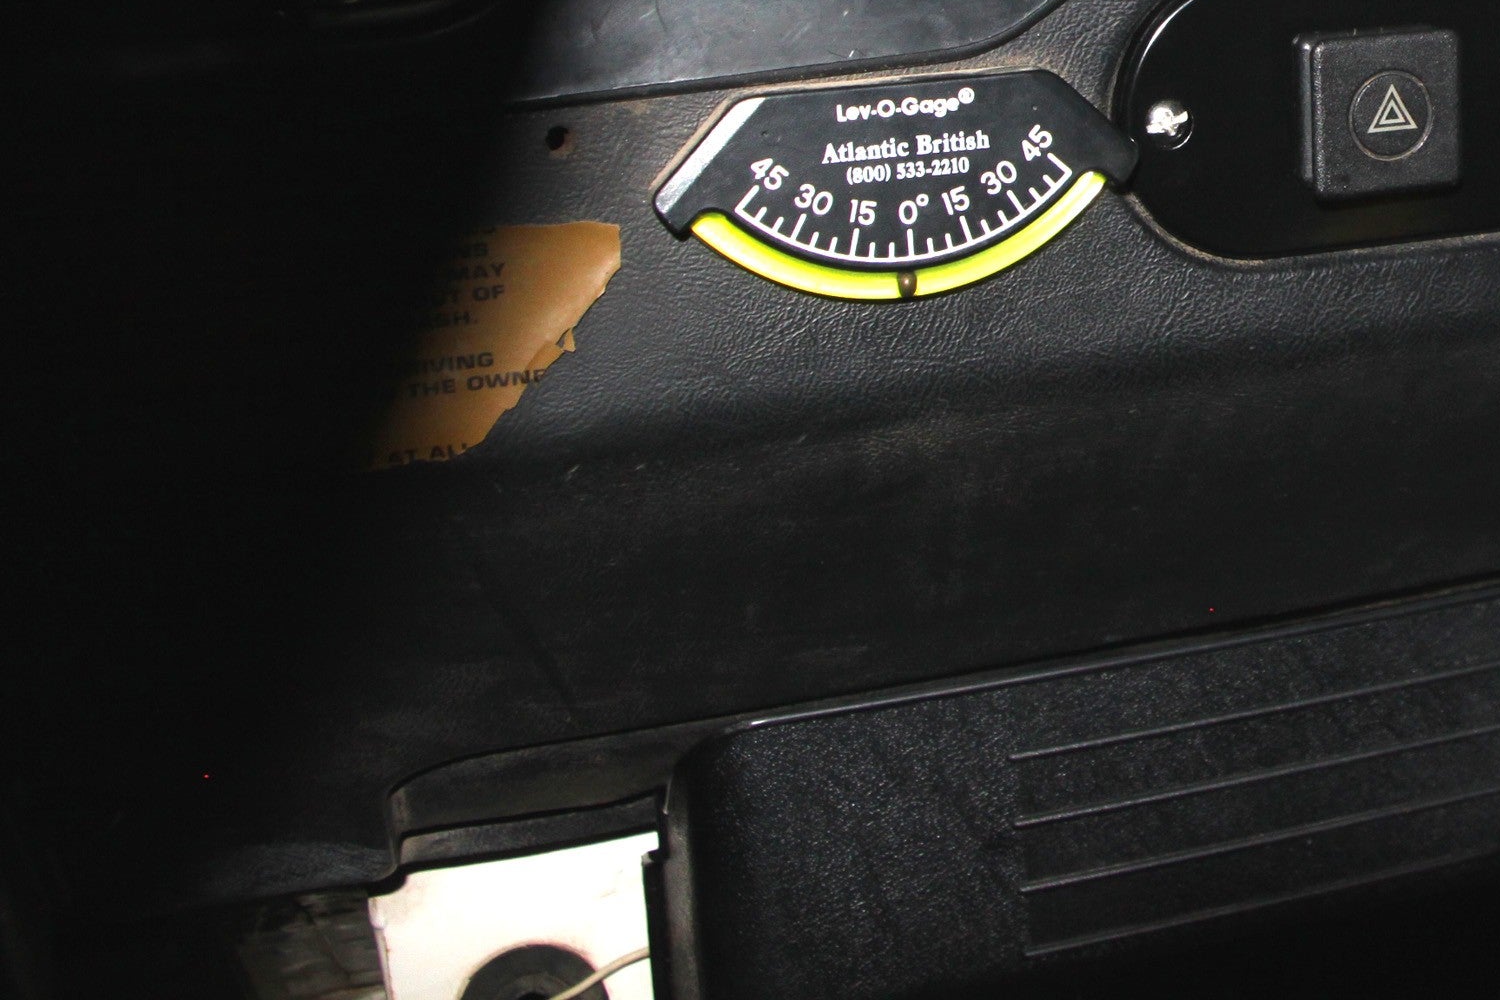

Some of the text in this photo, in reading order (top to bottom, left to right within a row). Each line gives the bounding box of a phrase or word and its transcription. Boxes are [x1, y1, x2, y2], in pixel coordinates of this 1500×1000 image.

[821, 130, 991, 165] Atlantic British
[750, 157, 790, 191] 45
[794, 184, 834, 216] 30
[850, 199, 877, 226] 15
[942, 185, 971, 215] 15
[980, 159, 1018, 195] 30
[1020, 124, 1054, 162] 45
[845, 156, 970, 186] (800) 533-2210
[472, 284, 506, 302] OF
